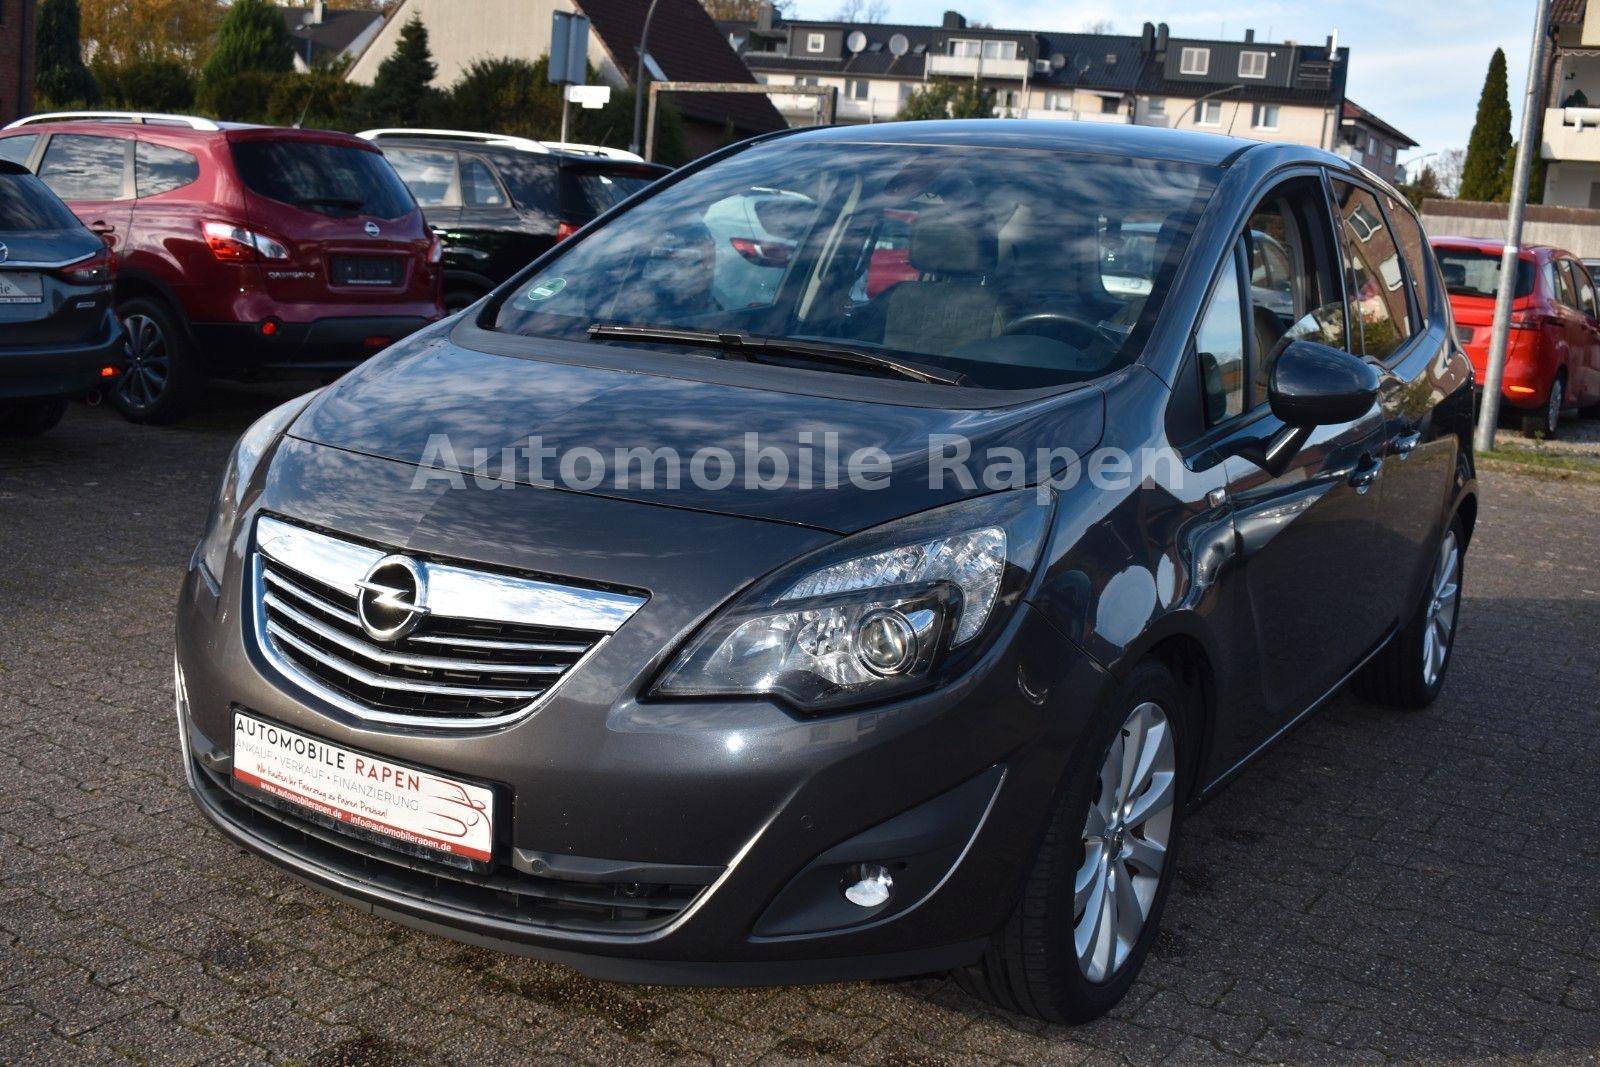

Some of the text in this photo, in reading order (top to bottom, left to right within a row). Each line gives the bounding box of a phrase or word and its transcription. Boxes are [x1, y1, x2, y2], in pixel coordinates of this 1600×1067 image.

[235, 740, 419, 811] ANKAUF VERKAUF FINANZIERUNG
[236, 718, 420, 792] AUTOMOBILE RAPEN
[260, 781, 342, 819] www.automobilerapen.de
[350, 813, 452, 852] info@automobilerapen.de
